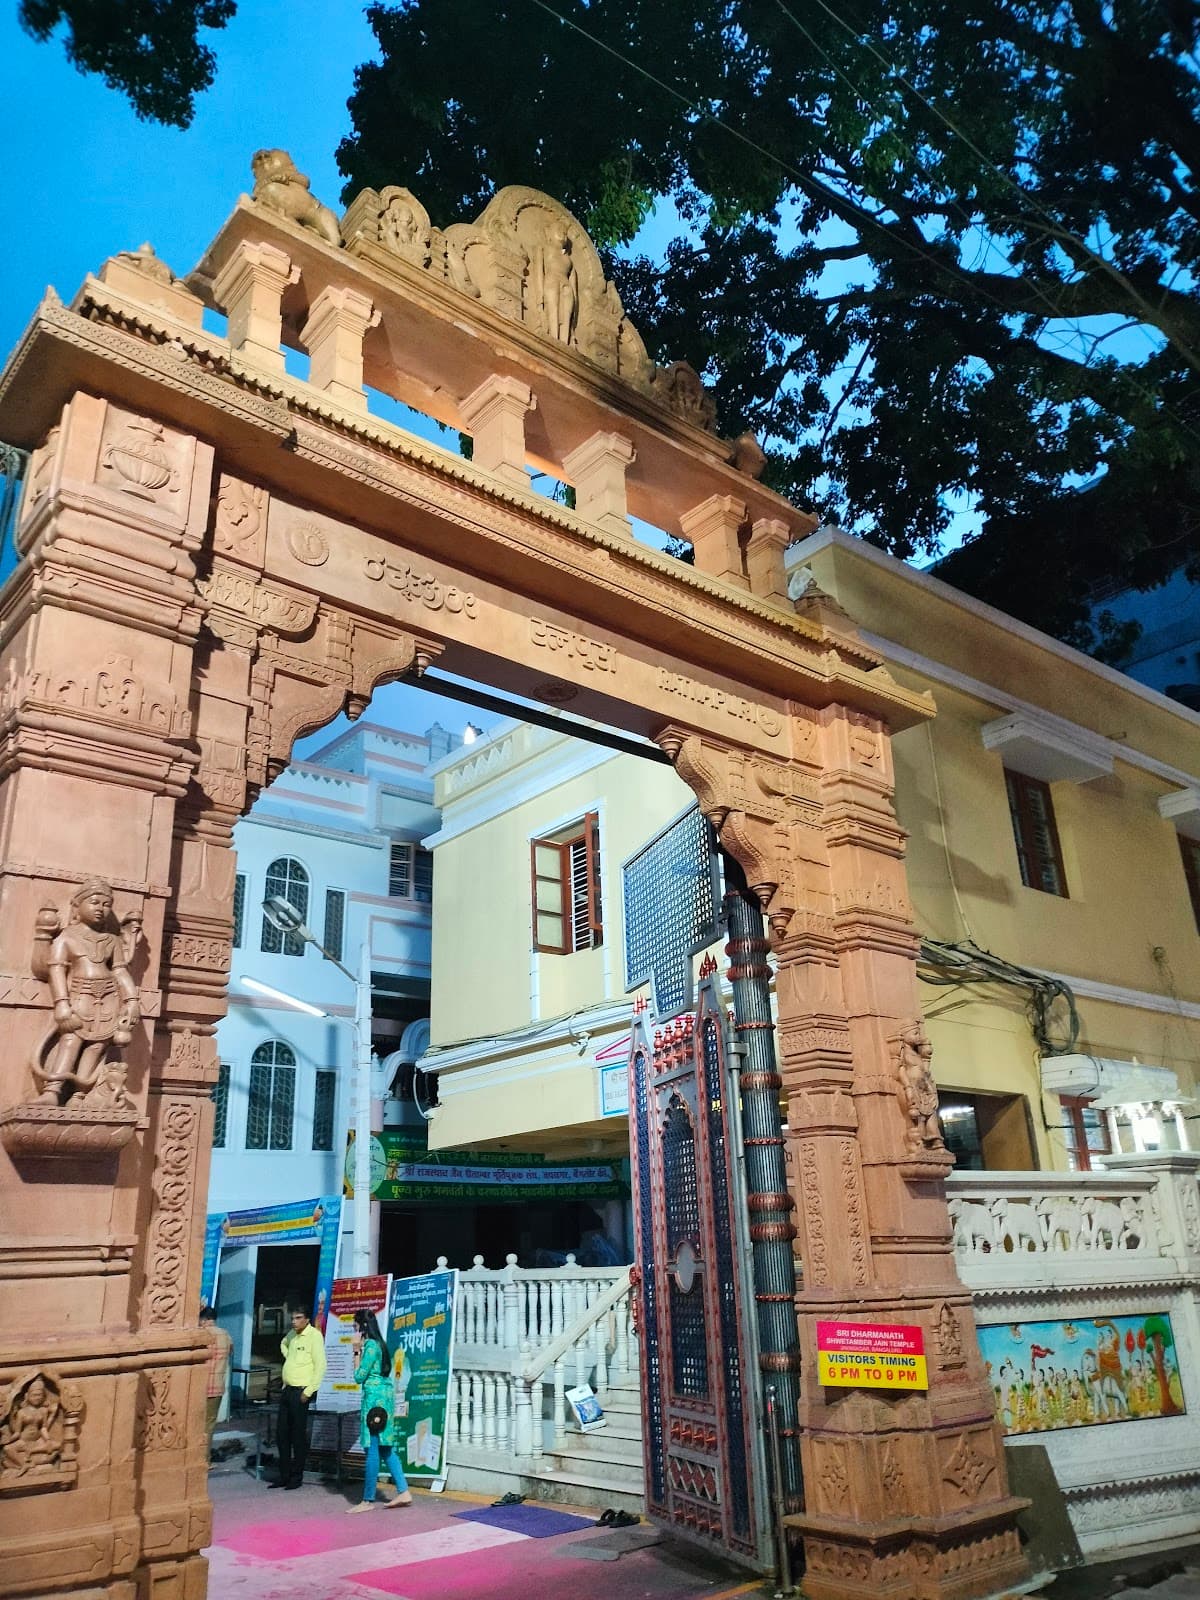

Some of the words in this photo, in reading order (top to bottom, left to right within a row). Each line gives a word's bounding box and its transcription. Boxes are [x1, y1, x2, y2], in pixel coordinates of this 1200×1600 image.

[400, 1328, 437, 1354] उपधान
[836, 1329, 850, 1337] SRI
[851, 1330, 904, 1340] DHARMANATH
[826, 1337, 872, 1346] SHWETAMBER
[873, 1339, 889, 1347] JAIN
[889, 1340, 915, 1348] TEMPLE
[828, 1354, 876, 1365] VISITORS
[879, 1356, 916, 1367] TIMING
[828, 1367, 836, 1378] 6
[841, 1367, 860, 1379] PM
[864, 1368, 882, 1380] TO
[898, 1370, 917, 1382] PM
